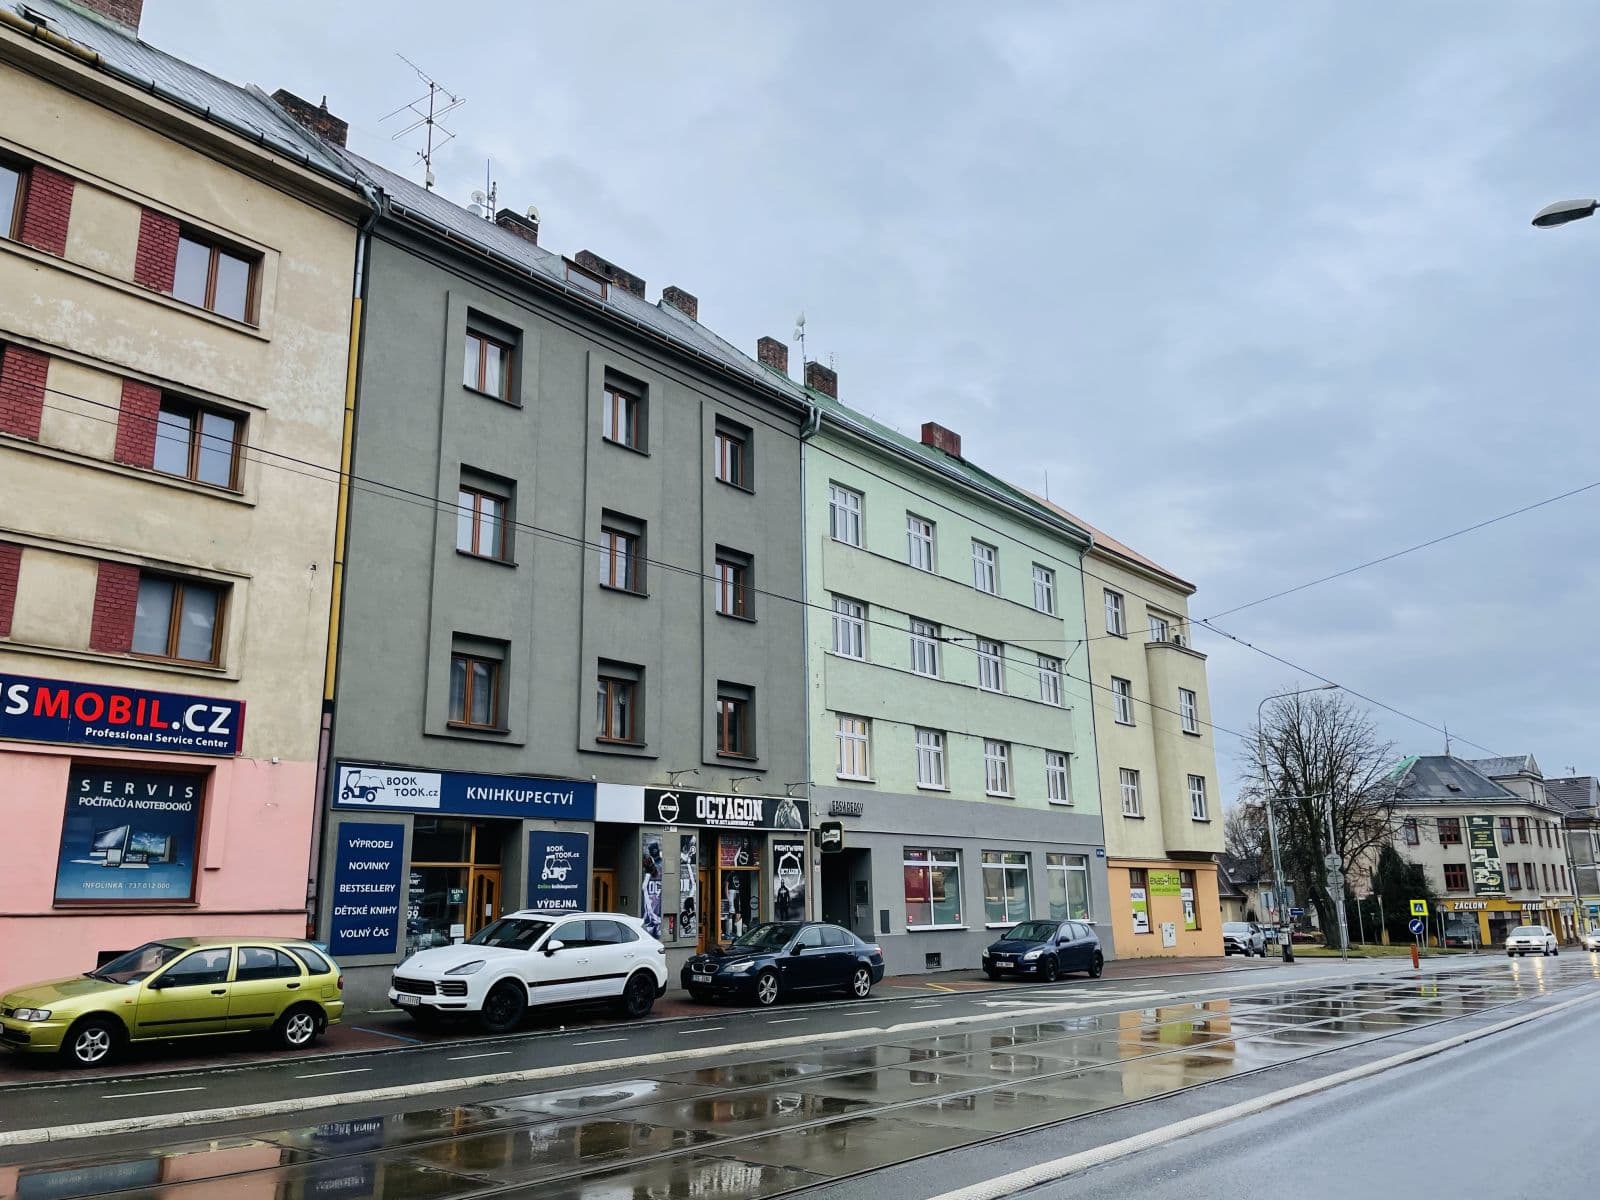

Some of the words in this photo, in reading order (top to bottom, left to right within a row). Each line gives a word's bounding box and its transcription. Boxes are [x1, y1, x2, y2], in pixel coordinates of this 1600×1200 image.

[0, 683, 232, 735] SMOBIL.CZ
[85, 726, 153, 742] Professional
[155, 734, 193, 745] Service
[195, 737, 228, 748] Center
[386, 776, 418, 786] BOOK
[80, 779, 194, 799] SERVIS
[393, 788, 439, 797] TOOK.cz
[466, 786, 574, 806] KNIHKUPECTVÍ
[126, 800, 134, 809] A
[135, 800, 192, 812] NOTEBOOKŮ
[696, 795, 763, 822] OCTAGON
[349, 838, 394, 849] VÝPRODEJ
[546, 845, 565, 853] BOOK
[348, 862, 390, 871] NOVINKY
[339, 884, 396, 893] BESTSELLERY
[536, 898, 578, 909] VÝDEJNA
[334, 905, 368, 916] DĚTSKÉ
[369, 906, 398, 915] KNIHY
[340, 927, 371, 938] VOLNÝ
[372, 926, 390, 937] ČAS
